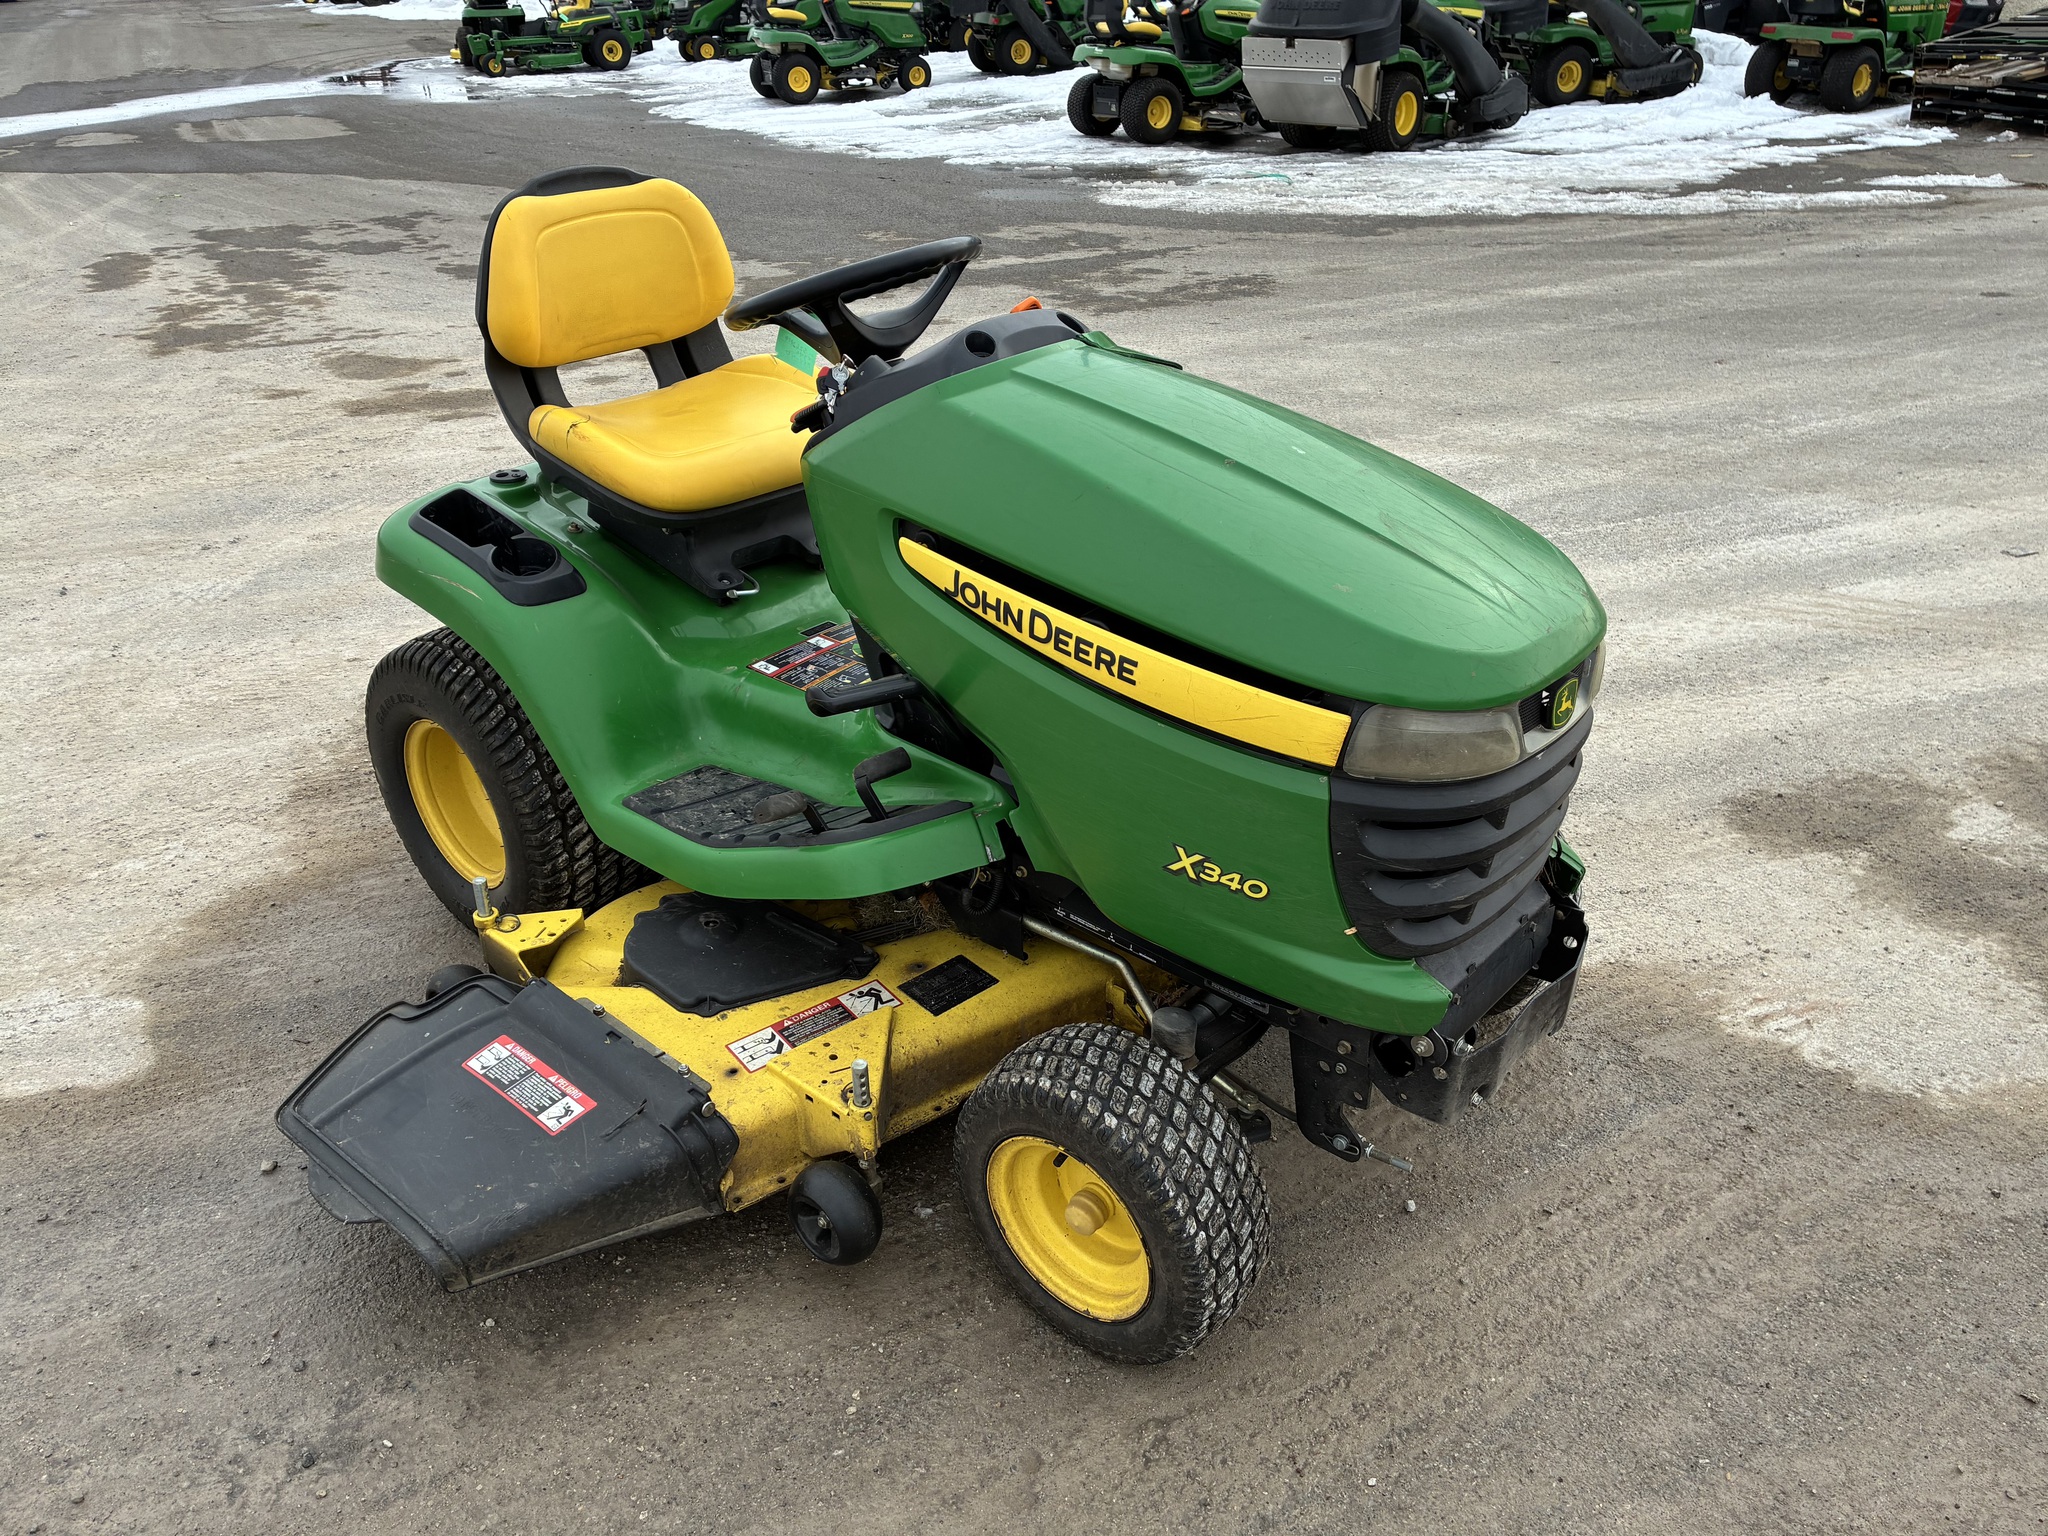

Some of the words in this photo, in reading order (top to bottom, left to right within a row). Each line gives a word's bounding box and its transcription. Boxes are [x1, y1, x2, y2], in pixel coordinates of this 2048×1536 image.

[944, 569, 1023, 633] JOHN
[1028, 607, 1139, 686] DEERE
[1164, 844, 1270, 900] X340
[791, 1002, 831, 1022] DANGER
[511, 1046, 537, 1064] DANGER
[556, 1078, 583, 1099] PELIGRO
